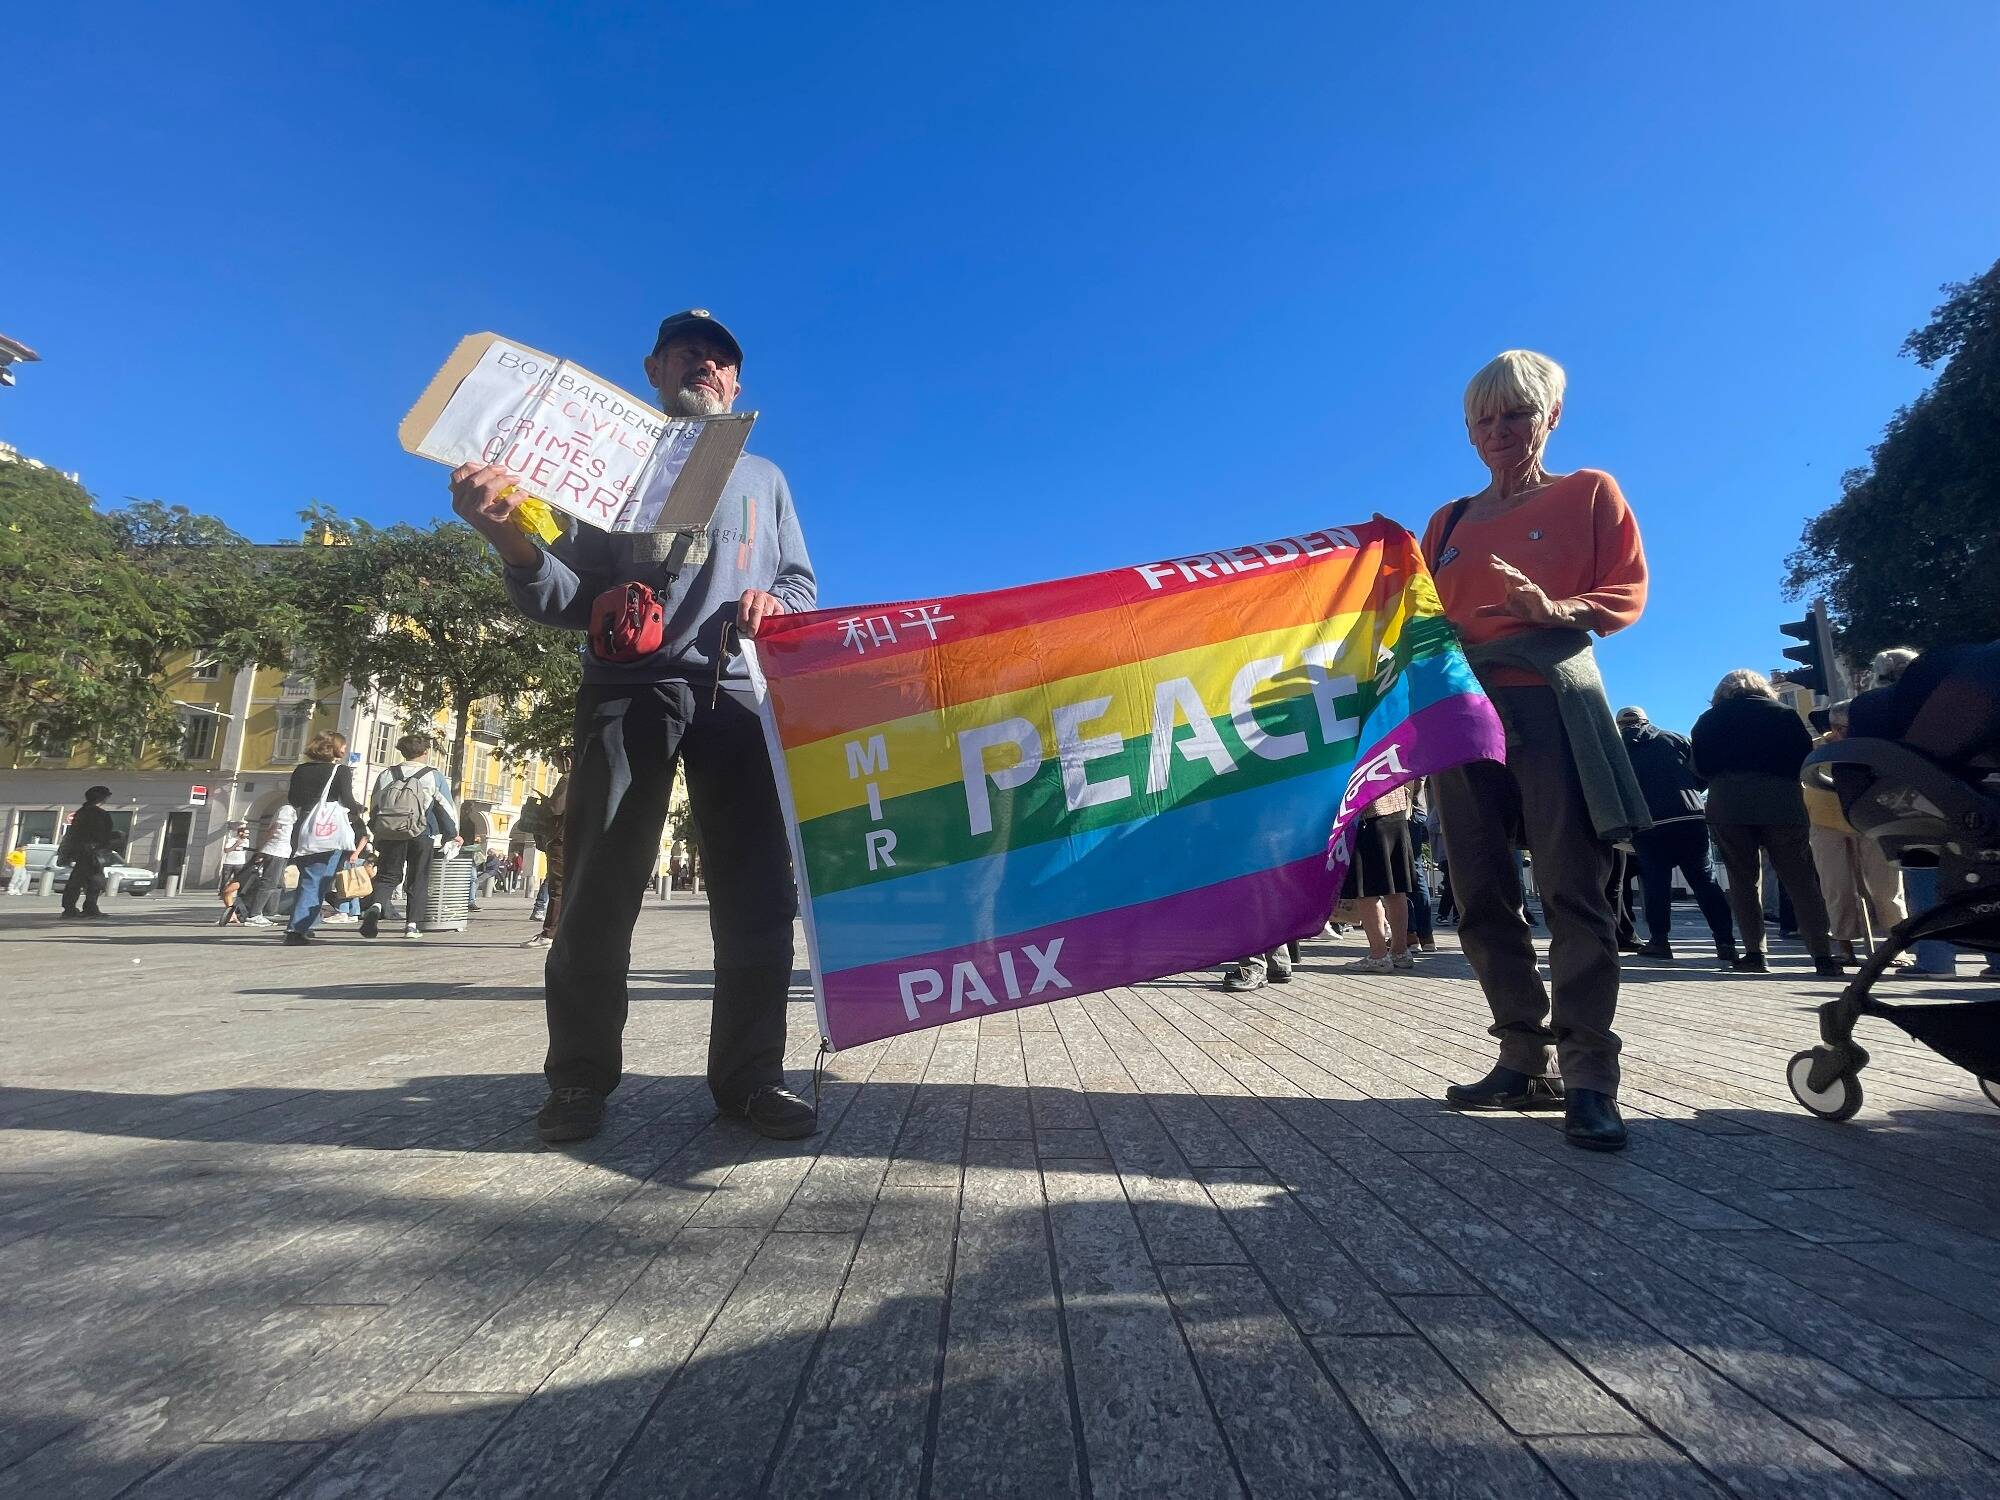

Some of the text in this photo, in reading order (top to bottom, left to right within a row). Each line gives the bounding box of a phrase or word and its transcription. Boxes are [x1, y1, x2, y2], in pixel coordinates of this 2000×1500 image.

[498, 352, 697, 440] BOMBARDEMENTS
[1133, 527, 1362, 591] FRIEDEN
[837, 603, 955, 655] 和平
[957, 639, 1361, 837] PEACE
[844, 733, 898, 871] MIR
[898, 936, 1073, 1022] PAIX
